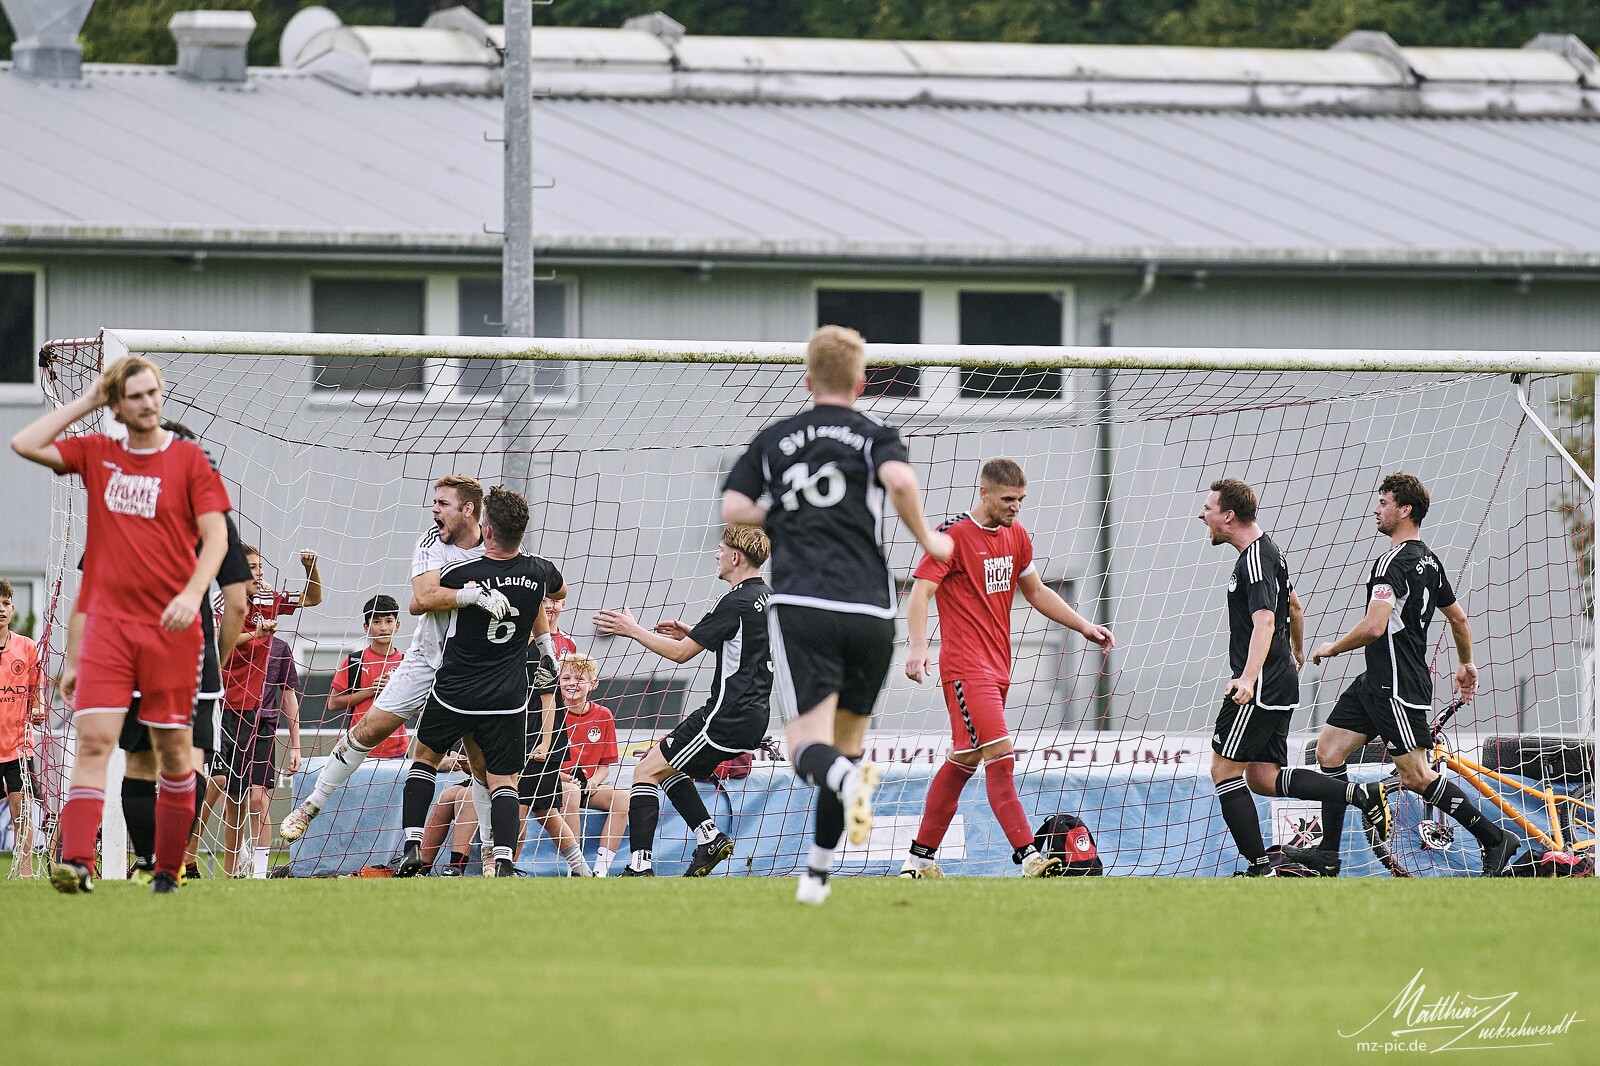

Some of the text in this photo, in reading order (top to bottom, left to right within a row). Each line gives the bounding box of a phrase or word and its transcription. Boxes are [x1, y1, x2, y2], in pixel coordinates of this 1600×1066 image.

[779, 424, 865, 456] SV Laufen
[496, 575, 539, 591] Laufen
[486, 606, 520, 644] 6
